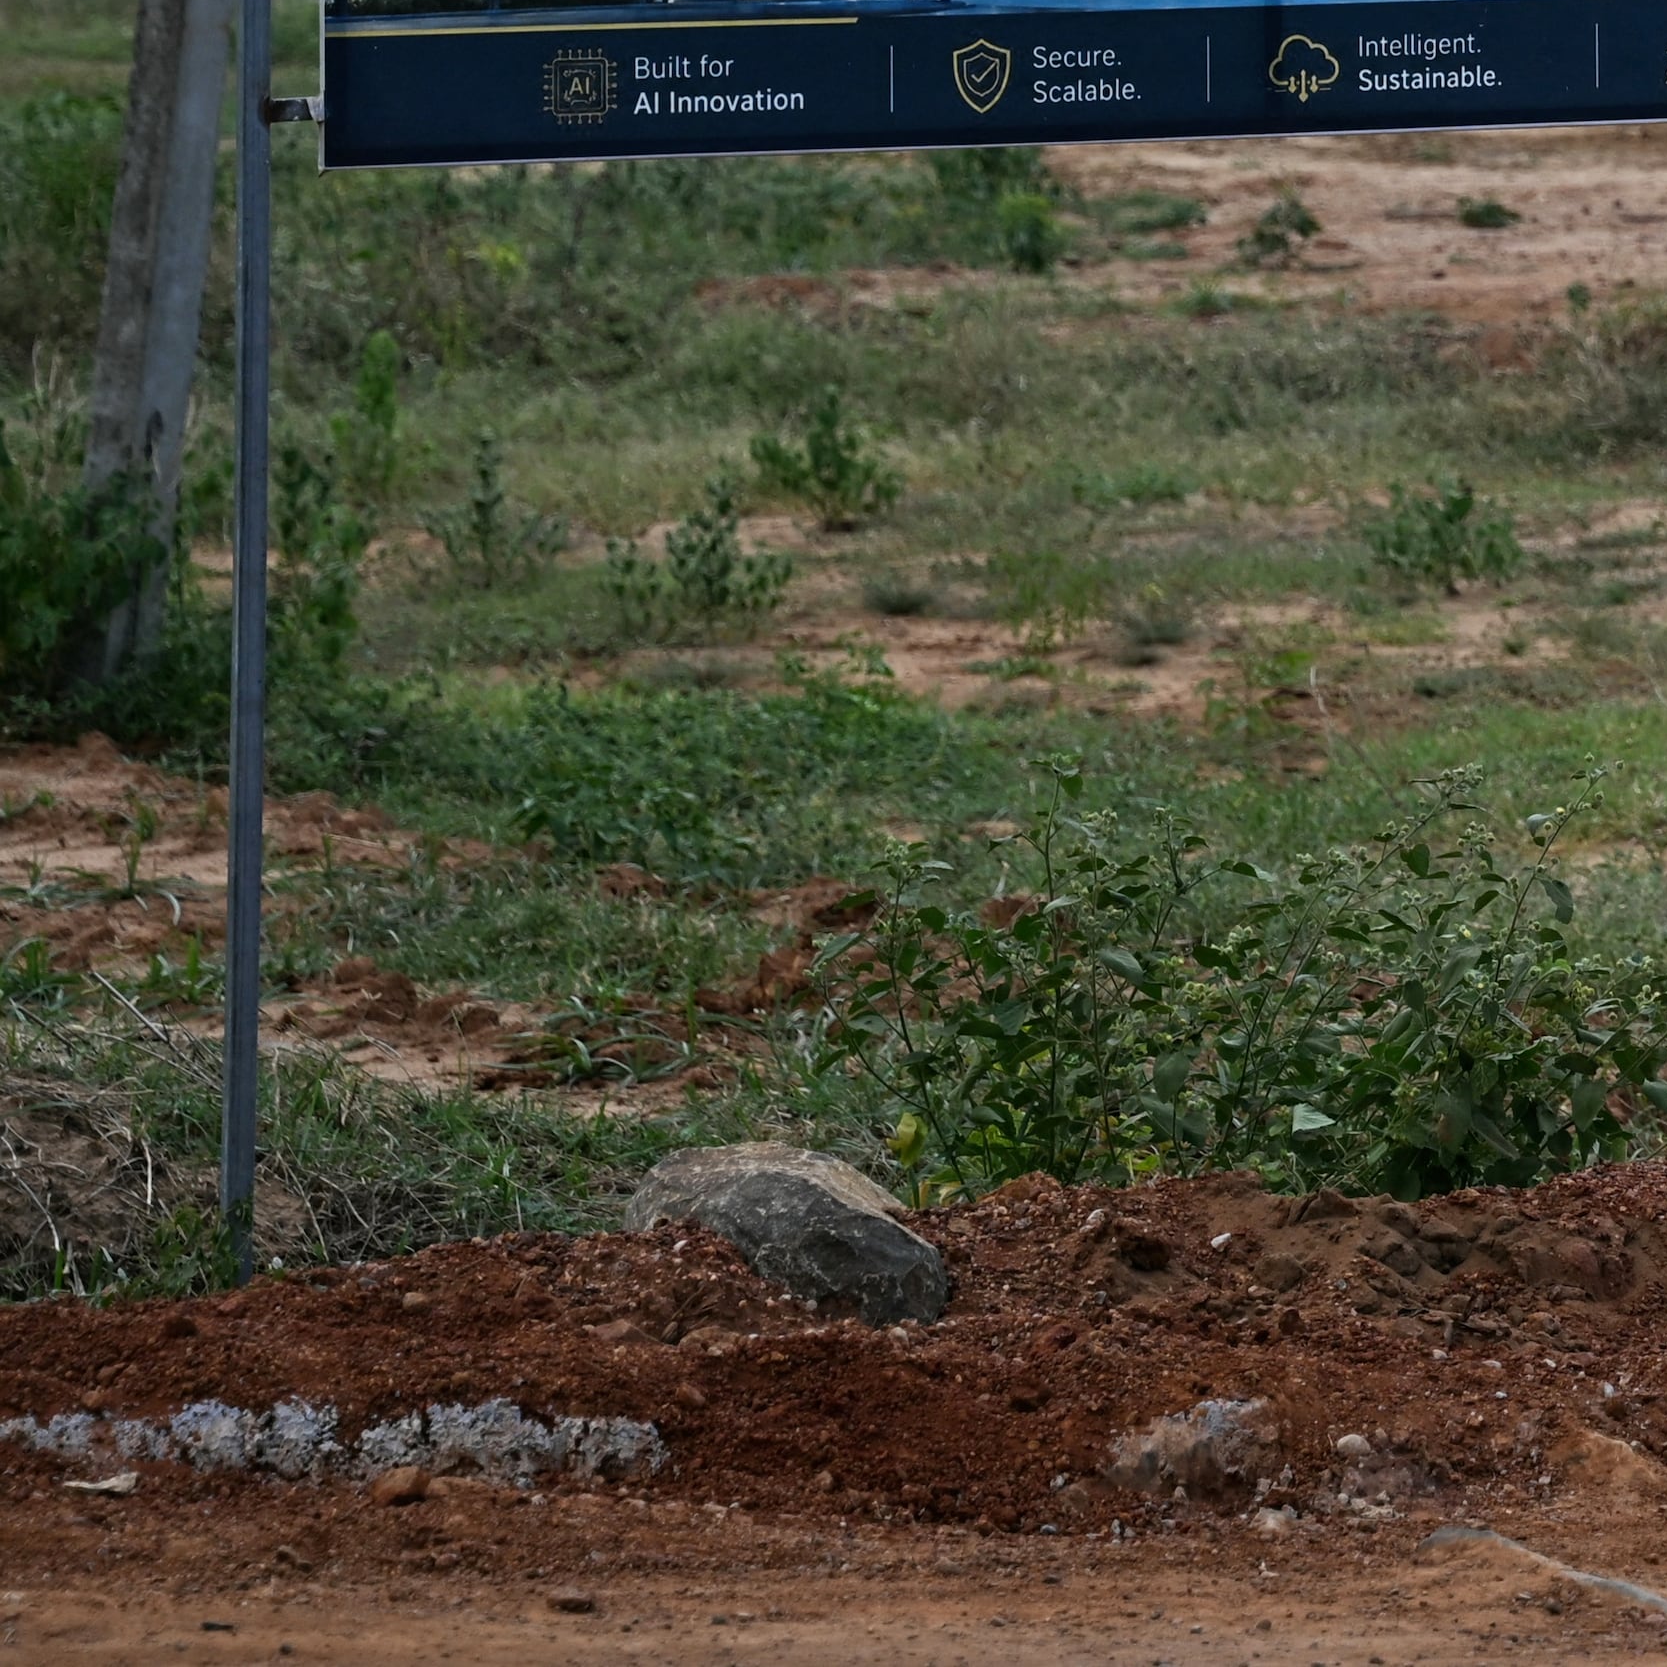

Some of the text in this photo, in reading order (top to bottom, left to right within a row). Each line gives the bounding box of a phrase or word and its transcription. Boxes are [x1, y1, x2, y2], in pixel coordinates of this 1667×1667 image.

[1034, 46, 1121, 68] Secure.
[1360, 34, 1480, 60] Intelligent.
[635, 55, 733, 79] Built for
[1359, 64, 1502, 92] Sustainable.
[568, 76, 590, 96] AI
[1034, 79, 1140, 103] Scalable.
[634, 88, 803, 114] AI Innovation
